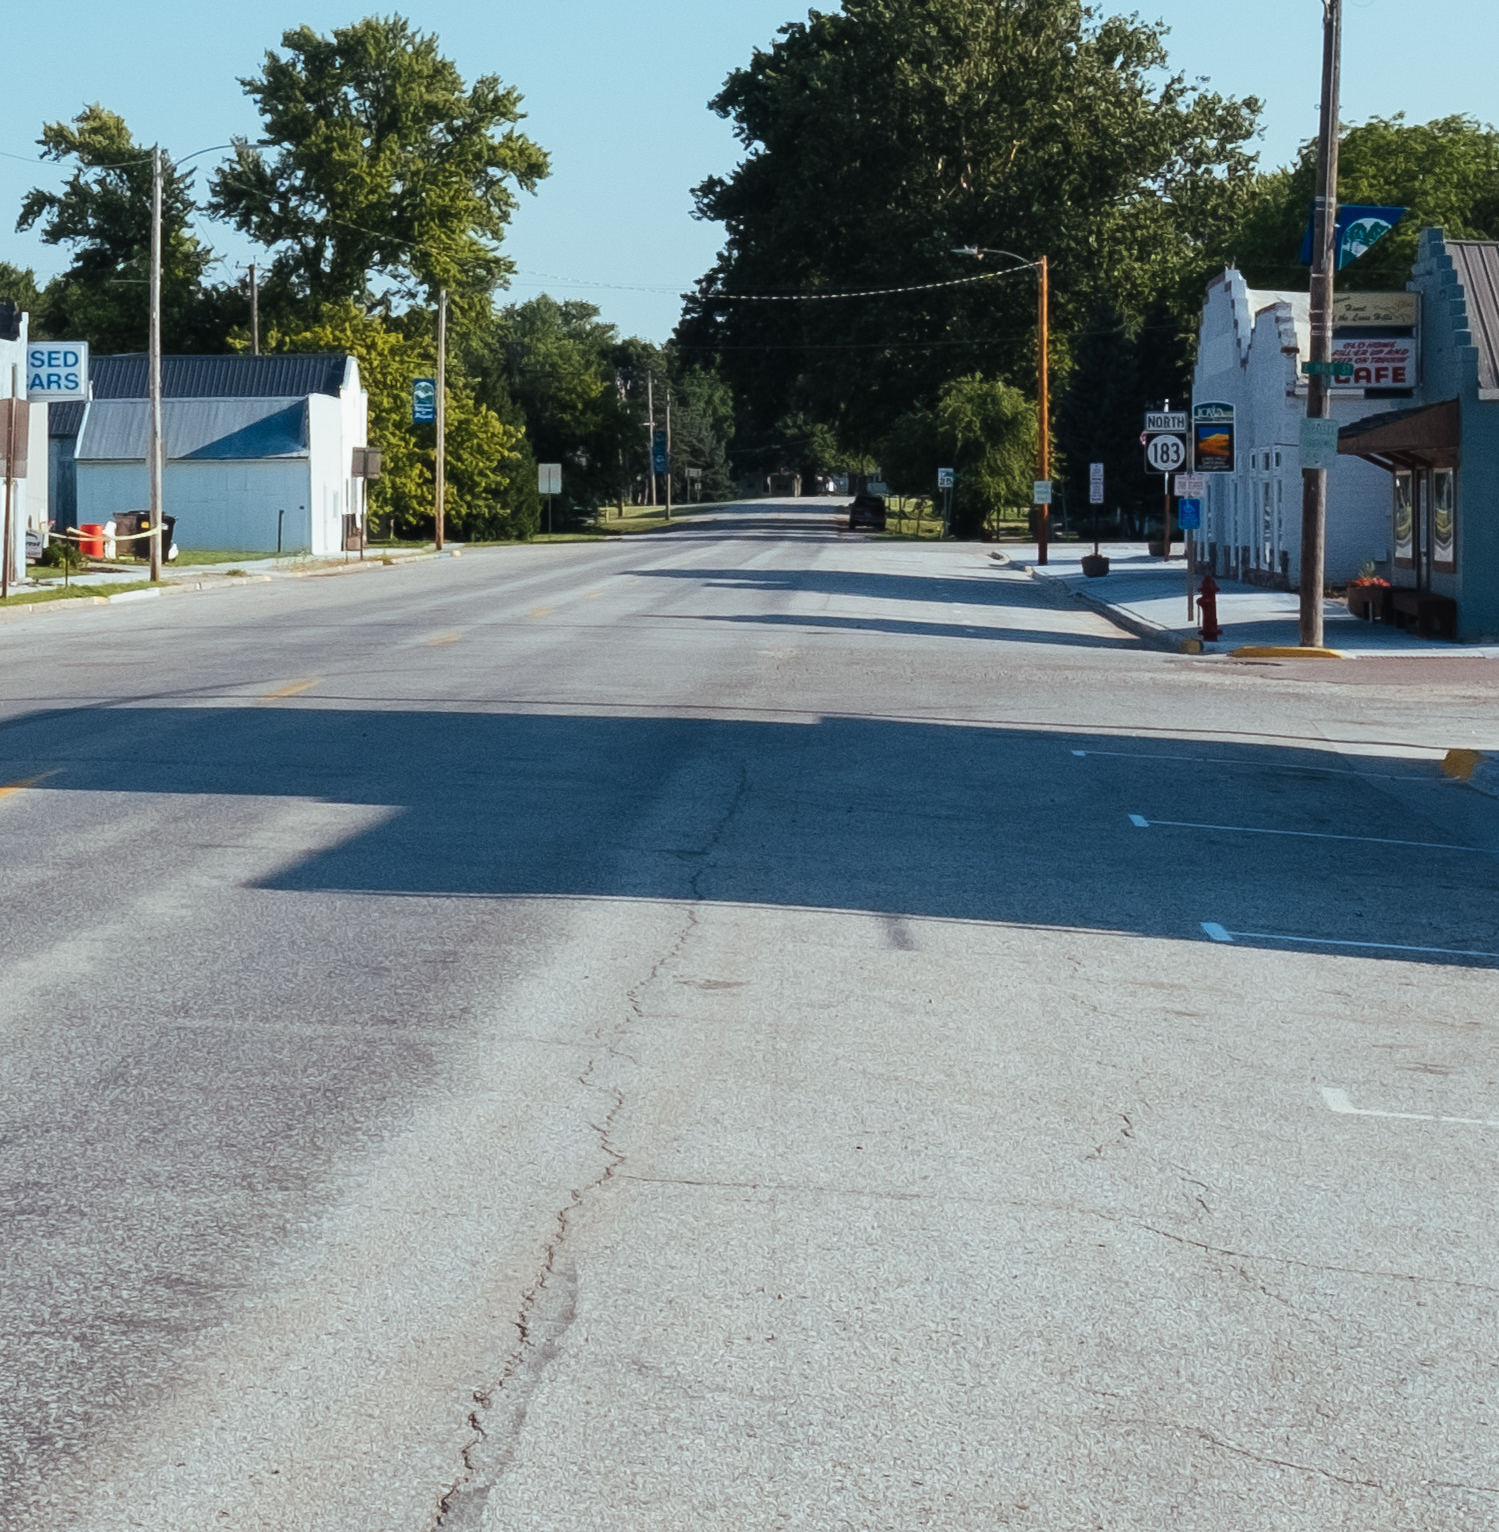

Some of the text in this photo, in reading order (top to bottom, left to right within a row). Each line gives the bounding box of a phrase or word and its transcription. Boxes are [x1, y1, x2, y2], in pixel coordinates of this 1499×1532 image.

[30, 350, 79, 368] SED
[27, 372, 79, 390] ARS
[1147, 415, 1185, 429] NORTH
[1152, 442, 1181, 464] 183
